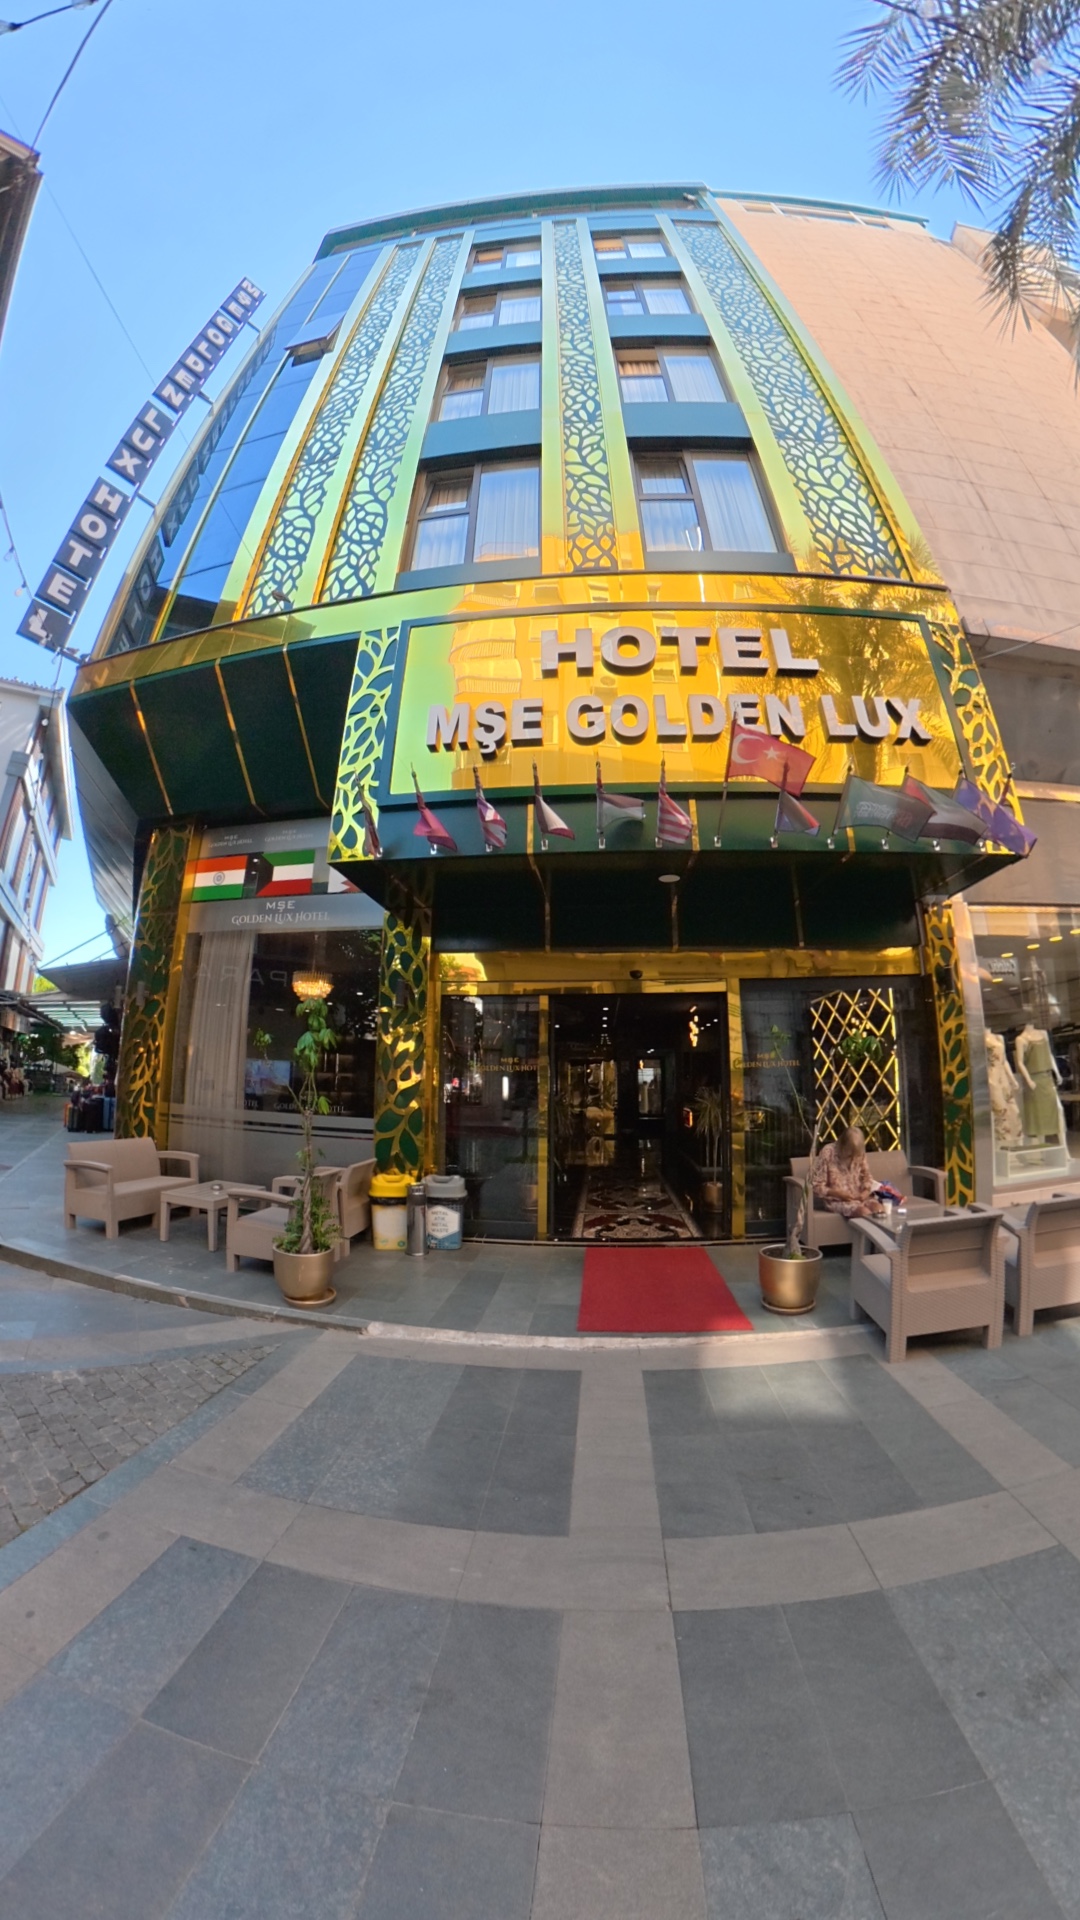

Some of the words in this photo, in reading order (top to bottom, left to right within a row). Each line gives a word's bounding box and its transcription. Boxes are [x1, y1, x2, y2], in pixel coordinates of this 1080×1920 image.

[162, 315, 234, 410] GOLDEN
[114, 408, 164, 476] LUX
[28, 484, 124, 640] HOTEL
[541, 626, 820, 677] HOTEL
[426, 697, 544, 760] MŞE
[566, 693, 808, 745] GOLDEN
[820, 694, 933, 745] LUX
[231, 913, 272, 926] GOLDEN
[274, 912, 294, 925] LUX
[294, 910, 330, 924] HOTEL
[266, 900, 296, 913] MŞE
